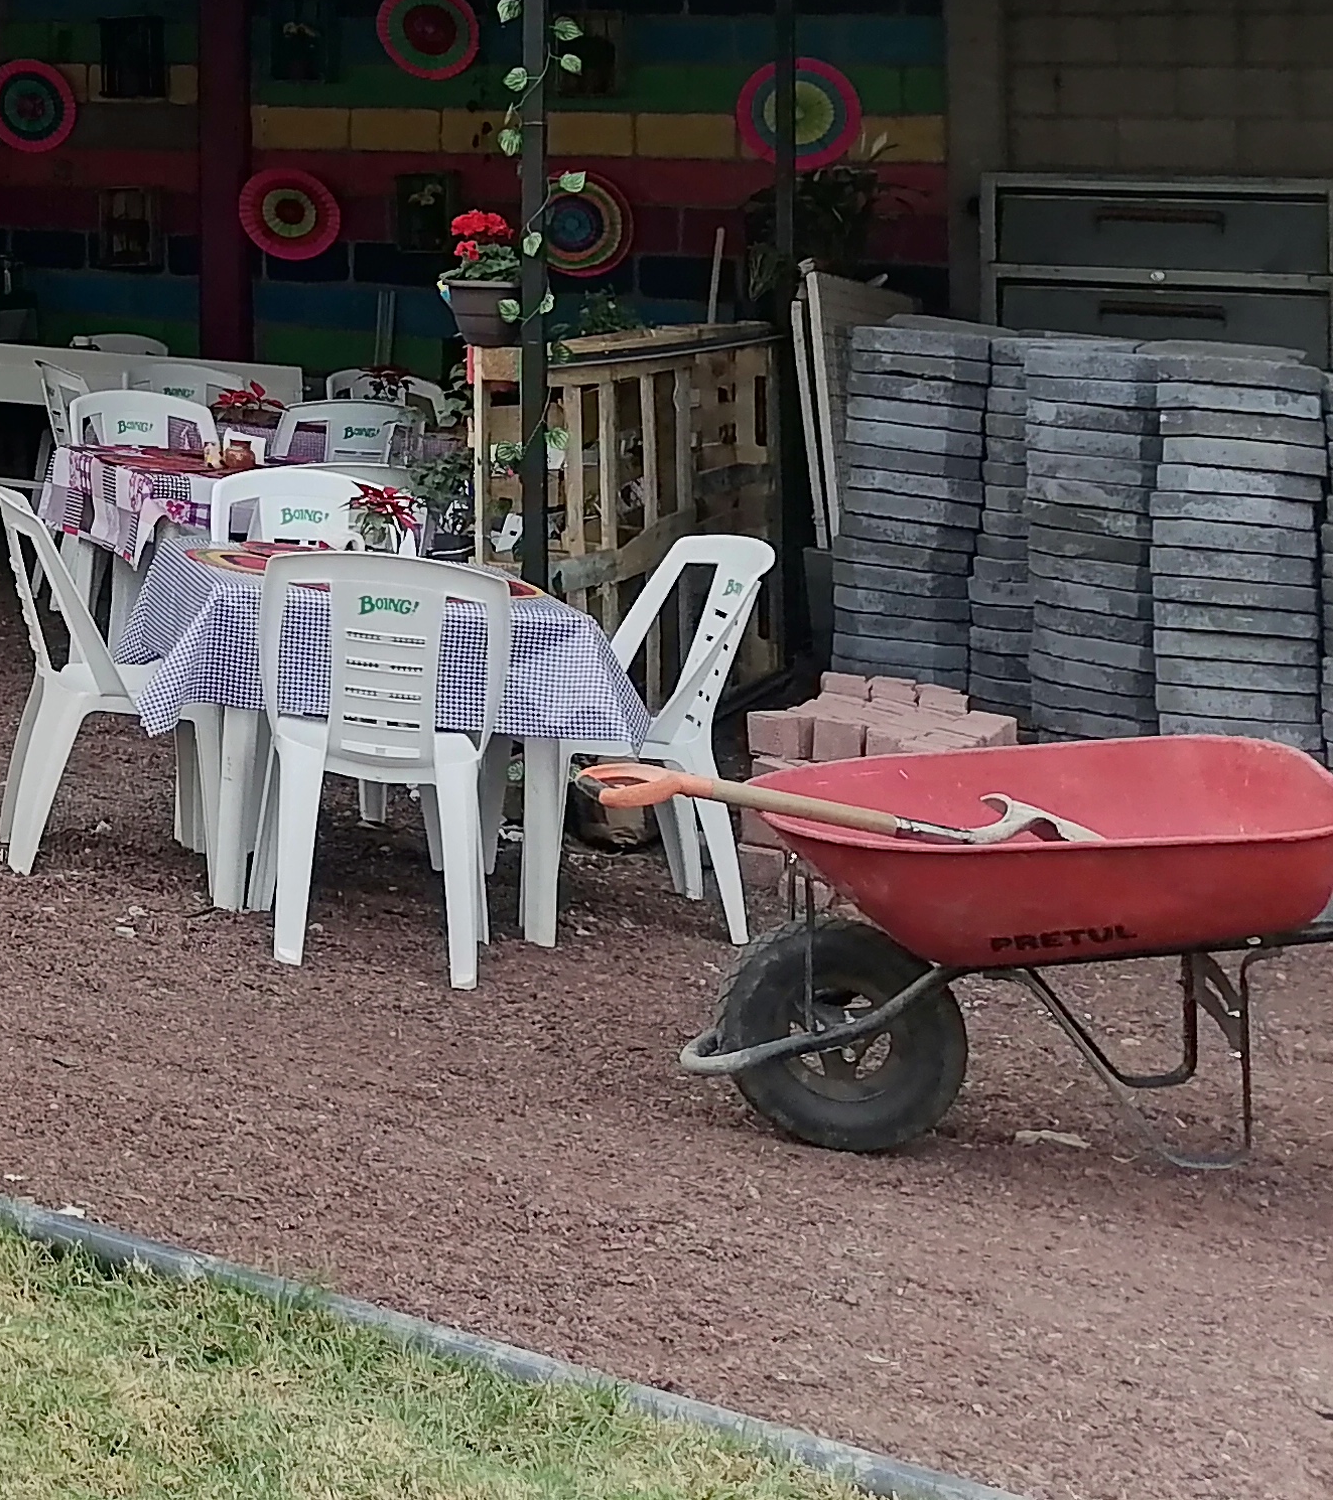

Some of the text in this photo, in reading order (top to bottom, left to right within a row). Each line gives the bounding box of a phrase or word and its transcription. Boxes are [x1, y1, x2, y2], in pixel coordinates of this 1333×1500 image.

[343, 426, 380, 440] BOING!
[280, 507, 329, 526] BOING!
[358, 595, 420, 616] BOING!
[990, 924, 1138, 952] PRETUL
